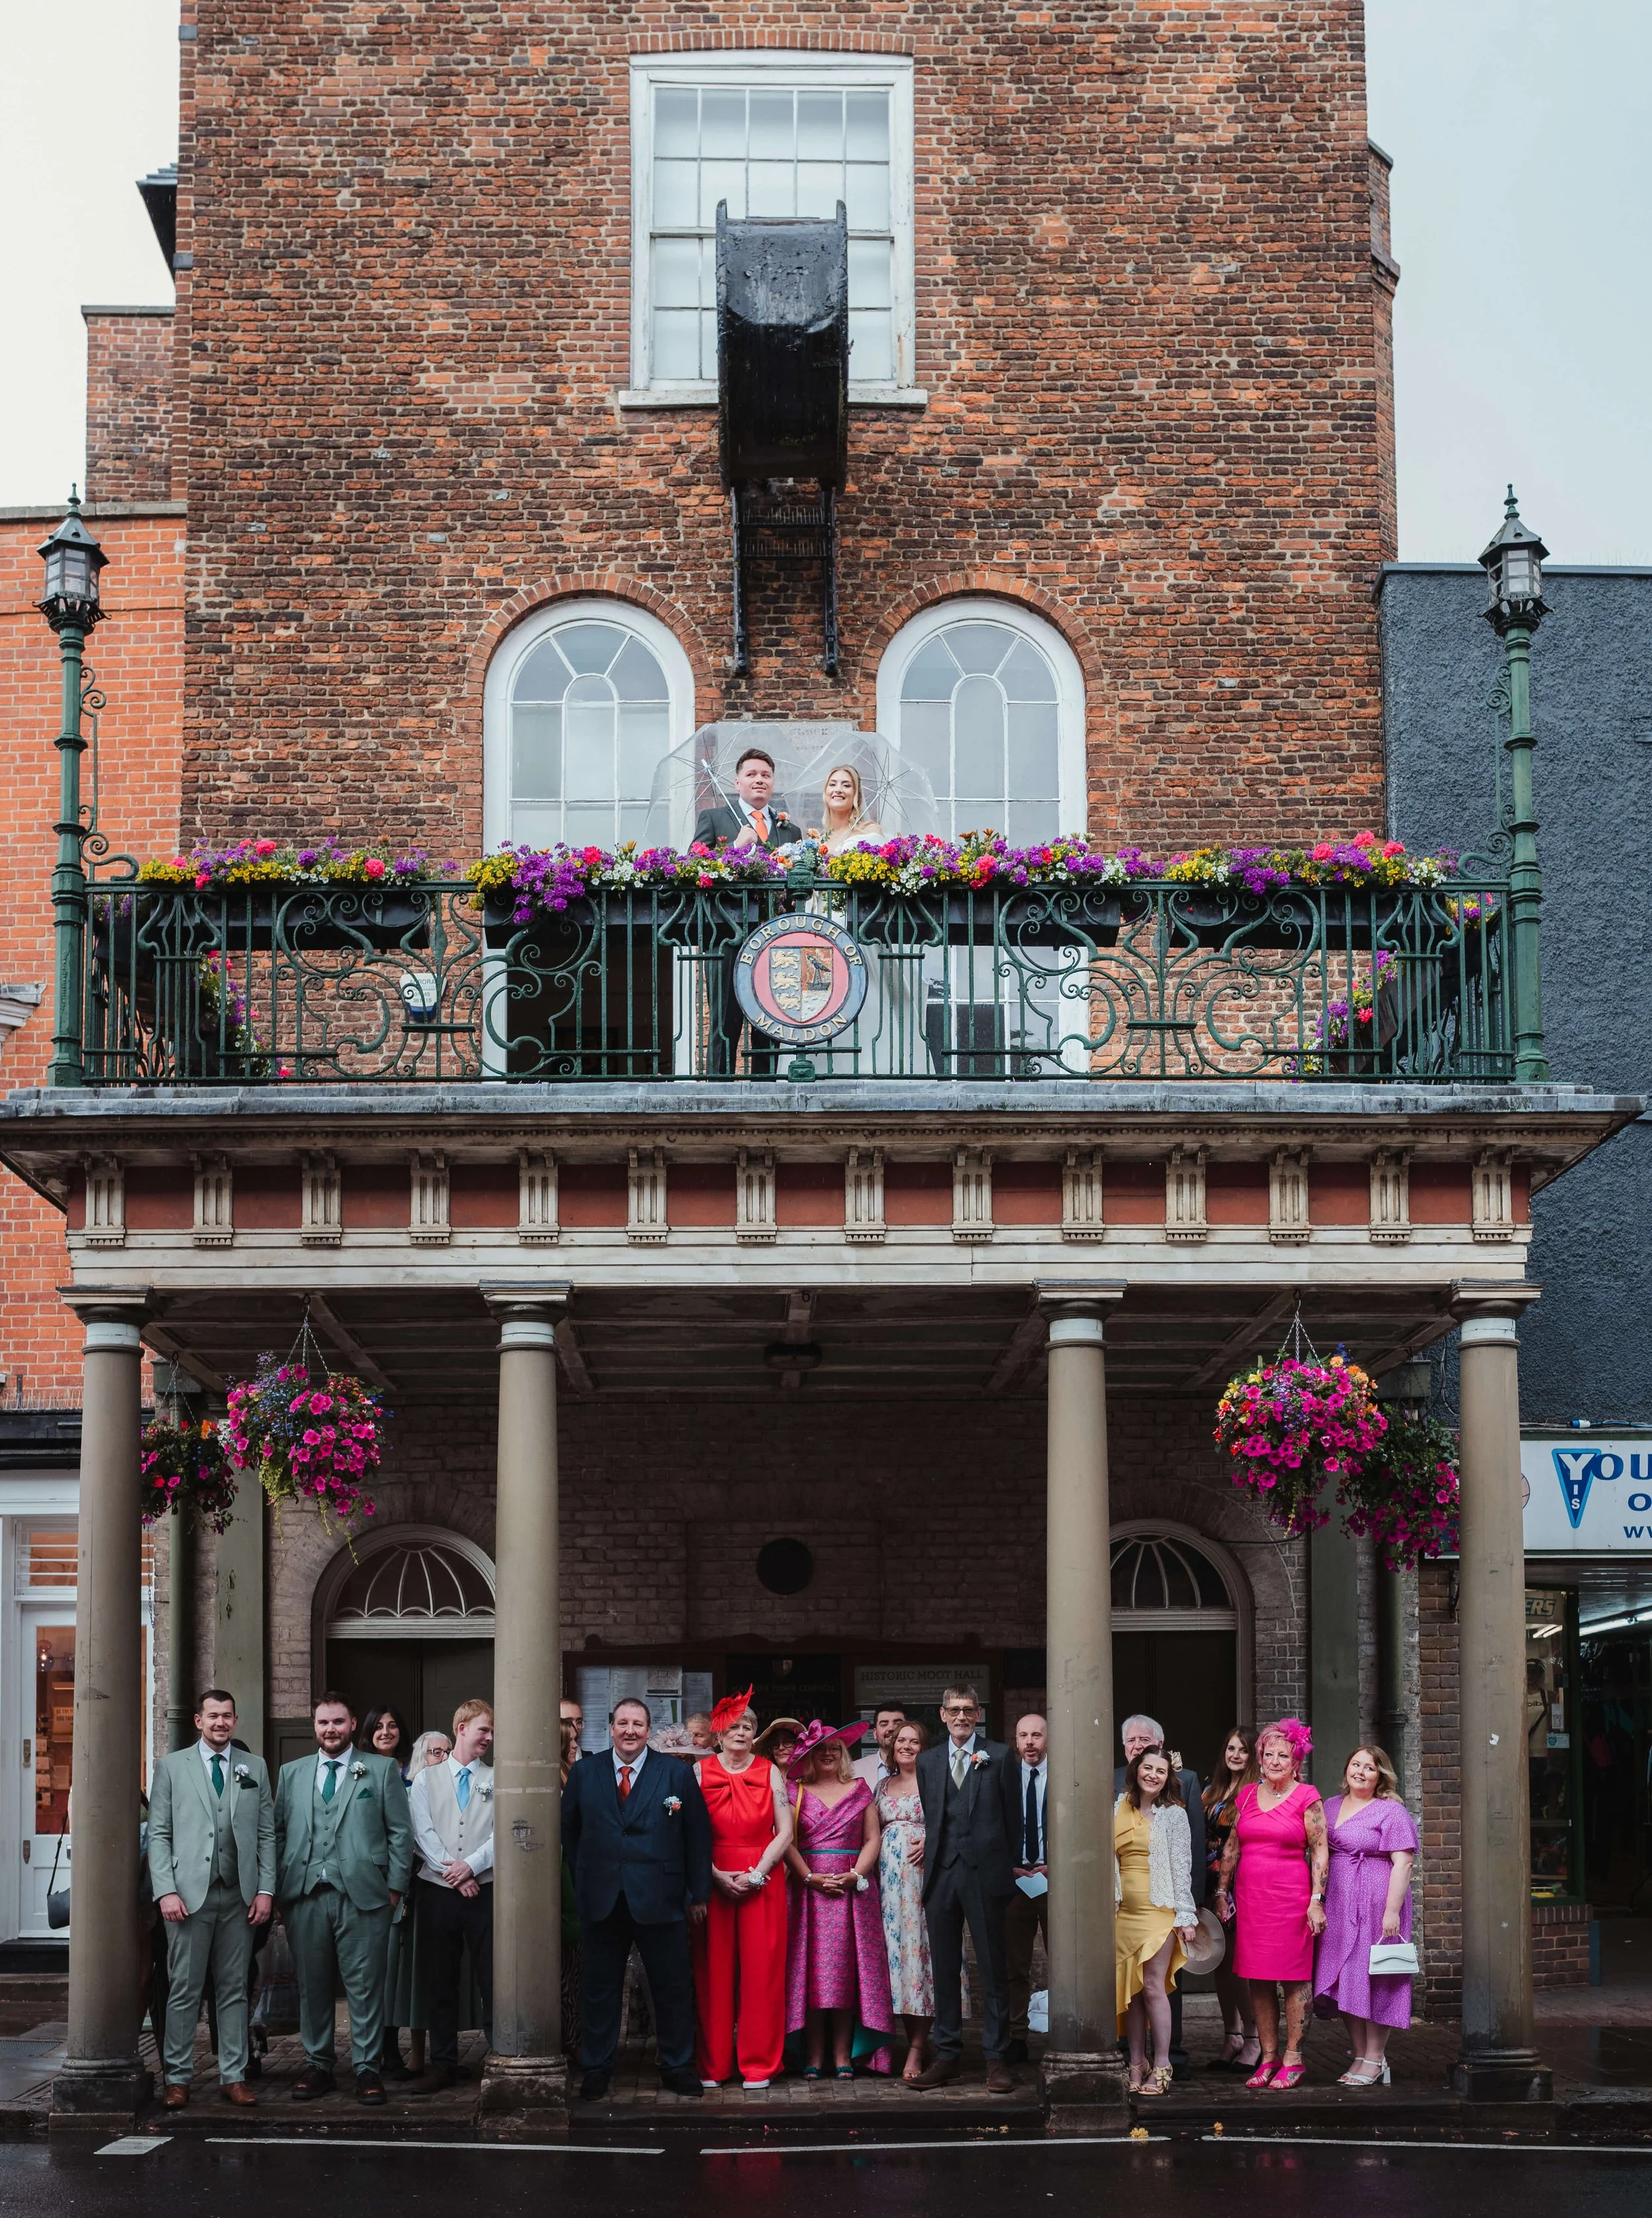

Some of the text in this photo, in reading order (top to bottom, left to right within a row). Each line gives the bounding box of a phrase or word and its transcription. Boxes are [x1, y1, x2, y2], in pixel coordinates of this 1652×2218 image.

[739, 916, 863, 967] BOROUGH OF
[755, 1012, 848, 1042] MALDON
[861, 1670, 983, 1681] HISTORIC MOOT HALL
